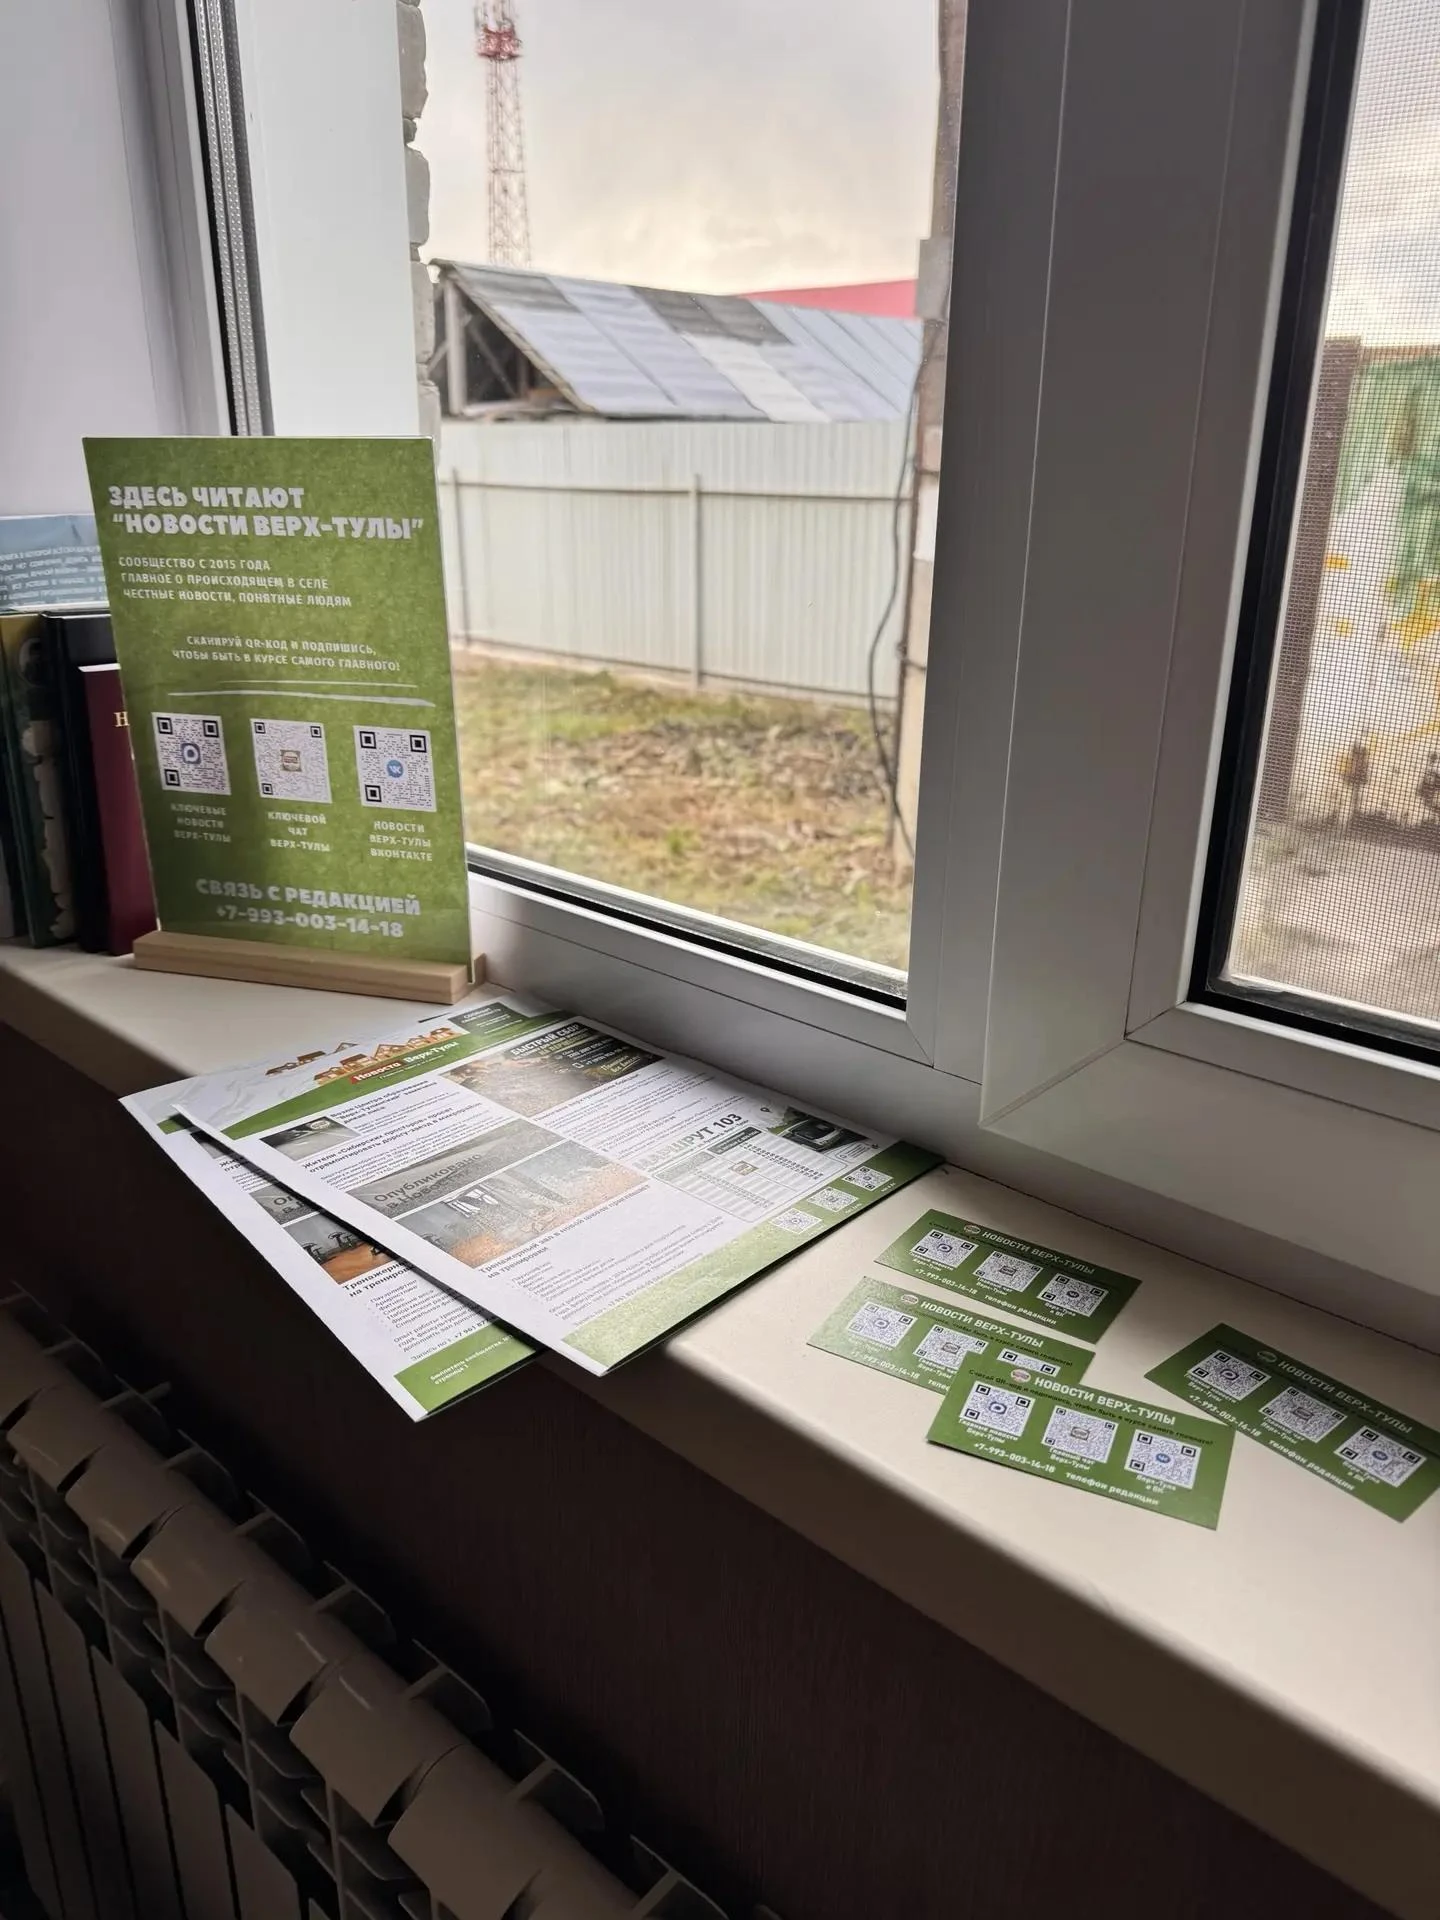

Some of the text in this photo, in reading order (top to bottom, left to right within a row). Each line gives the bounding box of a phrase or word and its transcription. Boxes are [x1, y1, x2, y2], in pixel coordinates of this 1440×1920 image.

[108, 486, 304, 509] ЗДЕСЬ ЧИТАЮТ
[119, 557, 270, 571] СООБЩЕСТВО С 2015 ГОДА
[121, 573, 328, 589] ГЛАВНОЕ О ПРОИСХОДЯЩЕМ В СЕЛЕ
[123, 589, 352, 607] ЧЕСТНЫЕ НОВОСТИ, ПОНЯТНЫЕ ЛЮДЯМ
[187, 634, 376, 656] СКАНИРУЙ QR-КОД И ПОДПИШИСЬ,
[172, 649, 401, 672] ЧТОБЫ БЫТЬ В КУРСЕ САМОГО ГЛАВНОГО!
[115, 711, 129, 728] Н
[170, 803, 227, 816] КЛЮЧЕВЫЕ
[268, 810, 327, 825] КЛЮЧЕВОЙ
[177, 817, 224, 829] НОВОСТИ
[288, 826, 308, 837] ЧАТ
[374, 821, 425, 833] НОВОСТИ
[174, 829, 231, 843] ВЕРХ-ТУЛЫ
[270, 838, 330, 852] ВЕРХ-ТУЛЫ
[370, 834, 432, 848] ВЕРХ-ТУЛЫ
[371, 848, 433, 862] ВКОНТАКТЕ
[196, 878, 421, 916] СВЯЗЬ С РЕДАКЦИЕЙ
[217, 905, 403, 938] +7-993-003-14-18
[713, 1113, 741, 1127] 103
[374, 1154, 483, 1202] Опубликовано
[478, 1243, 539, 1272] Тренажерный
[499, 1246, 548, 1271] тренировки
[982, 1231, 1094, 1273] НОВОСТИ ВЕРХ-ТУЛЫ
[984, 1294, 1016, 1309] телефон
[1017, 1307, 1056, 1324] редакции
[920, 1301, 1043, 1347] НОВОСТИ ВЕРХ-ТУЛЫ
[969, 1369, 993, 1380] Считай
[1034, 1377, 1174, 1424] НОВОСТИ ВЕРХ-ТУЛЫ
[1278, 1361, 1411, 1432] НОВОСТИ ВЕРХ-ТУЛЫ
[1269, 1440, 1306, 1463] телефон
[1306, 1462, 1353, 1489] редакции
[1066, 1472, 1106, 1488] телефон
[1108, 1486, 1158, 1504] редакции
